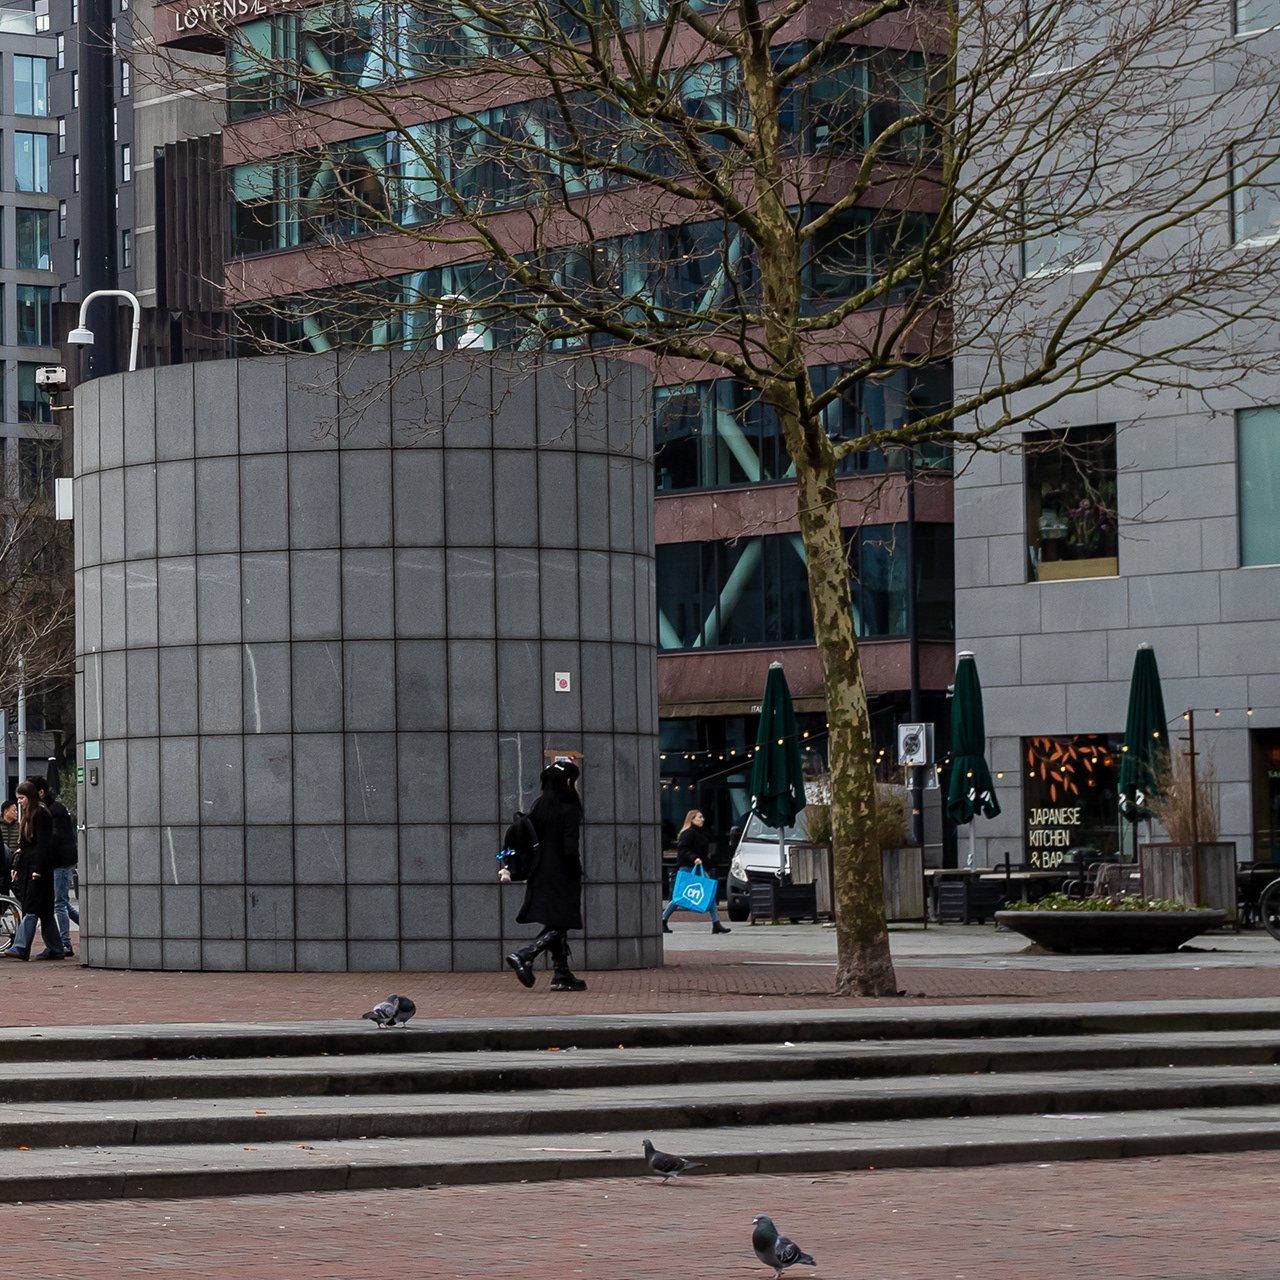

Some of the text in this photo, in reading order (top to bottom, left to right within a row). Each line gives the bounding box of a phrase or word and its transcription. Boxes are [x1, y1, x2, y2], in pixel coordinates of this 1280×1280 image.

[1029, 807, 1081, 825] JAPANESE
[1029, 829, 1070, 847] KITCHEN
[1030, 851, 1041, 868] &
